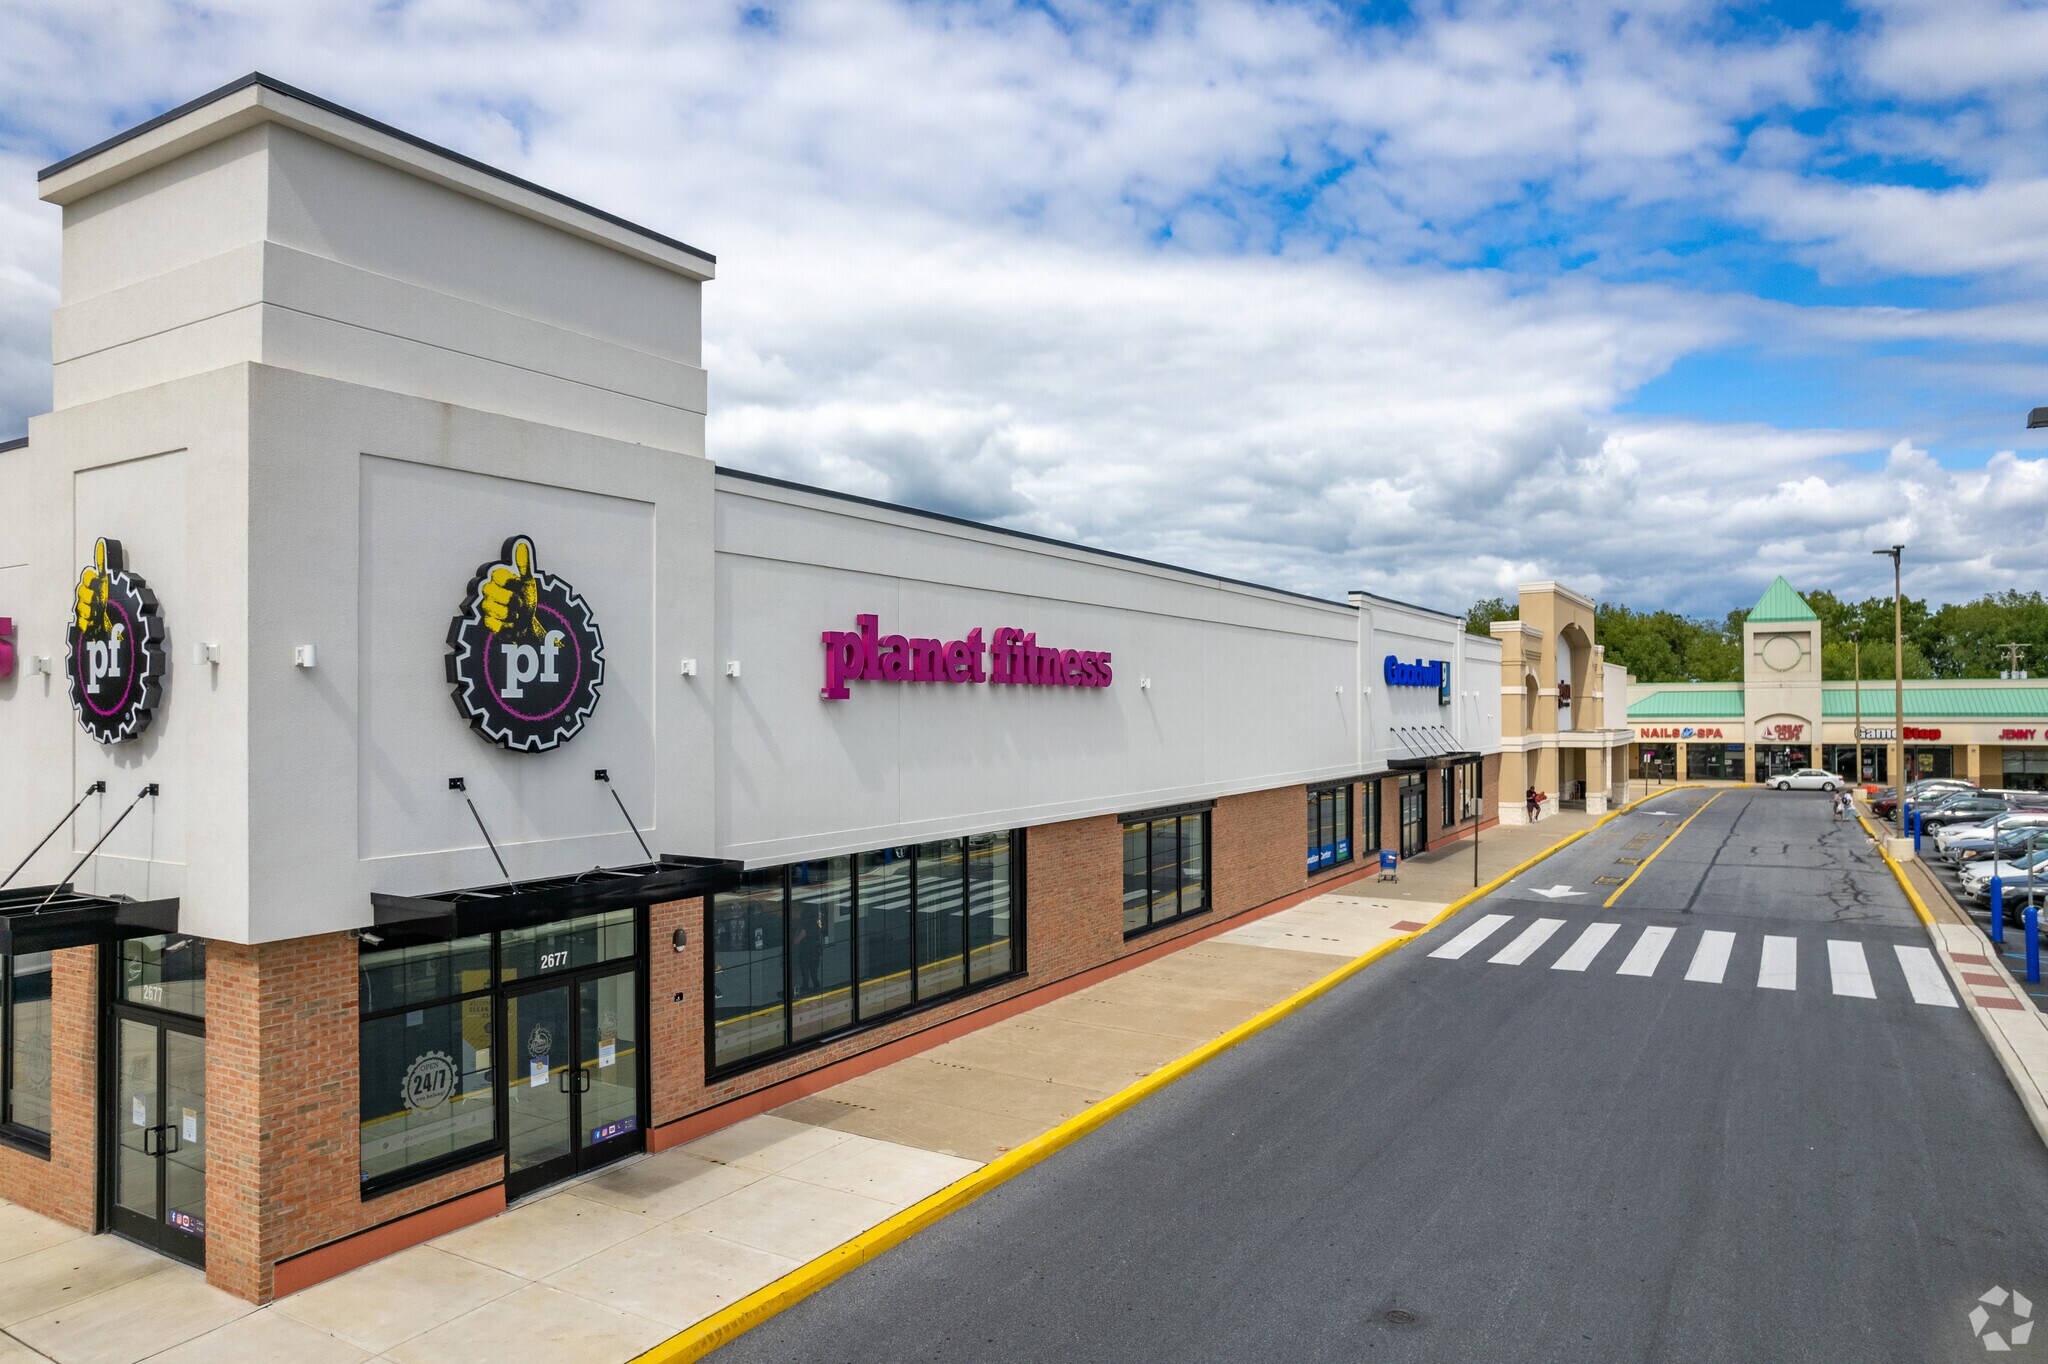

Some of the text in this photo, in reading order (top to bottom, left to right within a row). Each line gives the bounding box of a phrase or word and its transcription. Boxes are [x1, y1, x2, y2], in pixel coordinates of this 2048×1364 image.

[86, 623, 125, 694] pf
[500, 629, 566, 699] pf
[820, 613, 1113, 700] planet fitness
[1383, 654, 1441, 688] Goodwill
[1640, 727, 1723, 739] NAILS SPA
[1774, 724, 1804, 733] GREAT
[1778, 732, 1801, 741] CUTS
[1999, 728, 2037, 740] JENNY
[540, 950, 568, 970] 2677
[143, 984, 163, 1003] 2677
[420, 1061, 440, 1072] OPEN
[413, 1069, 447, 1096] 24/7
